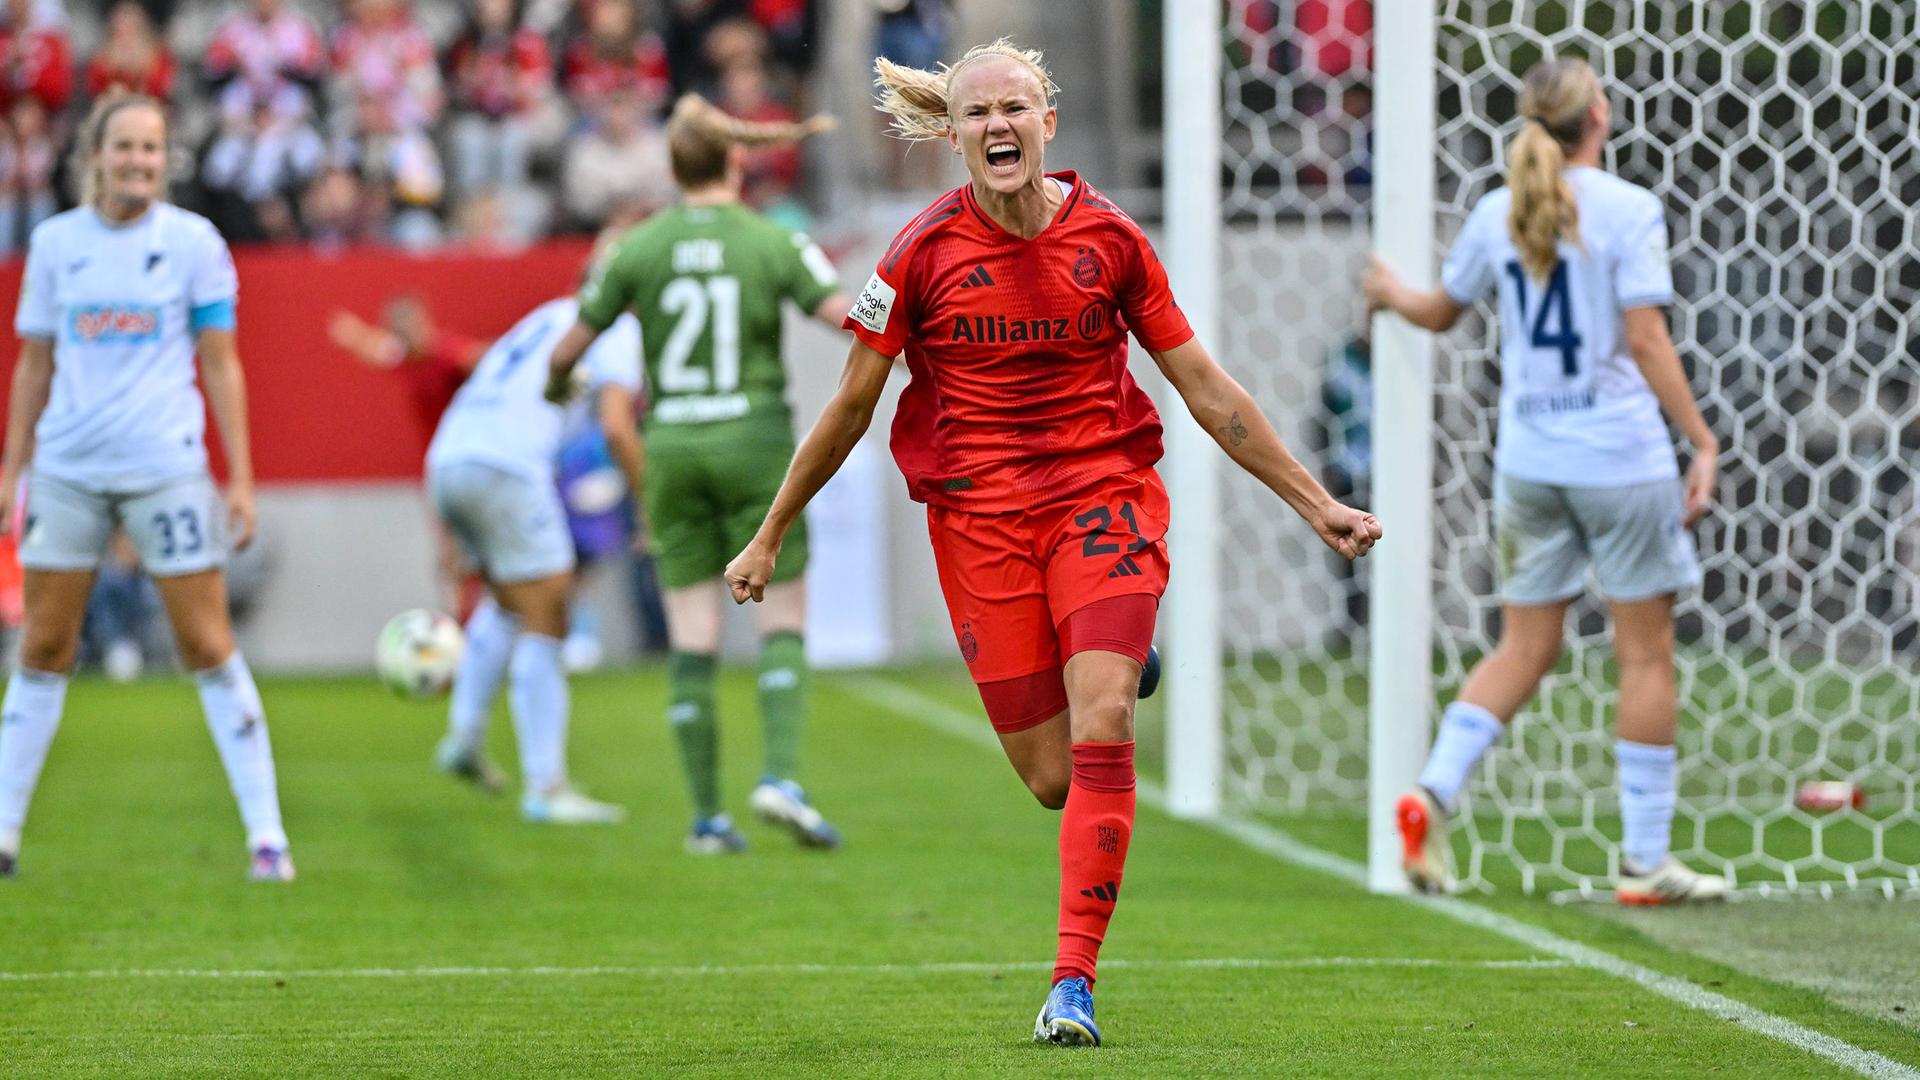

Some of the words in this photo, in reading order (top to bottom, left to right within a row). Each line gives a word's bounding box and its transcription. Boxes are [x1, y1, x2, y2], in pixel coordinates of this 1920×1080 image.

[659, 276, 740, 392] 21
[952, 315, 1070, 343] Allianz
[1506, 258, 1583, 375] 14
[152, 508, 203, 559] 33
[1074, 501, 1148, 557] 21
[1098, 825, 1118, 837] MIA
[1098, 841, 1117, 854] MIA
